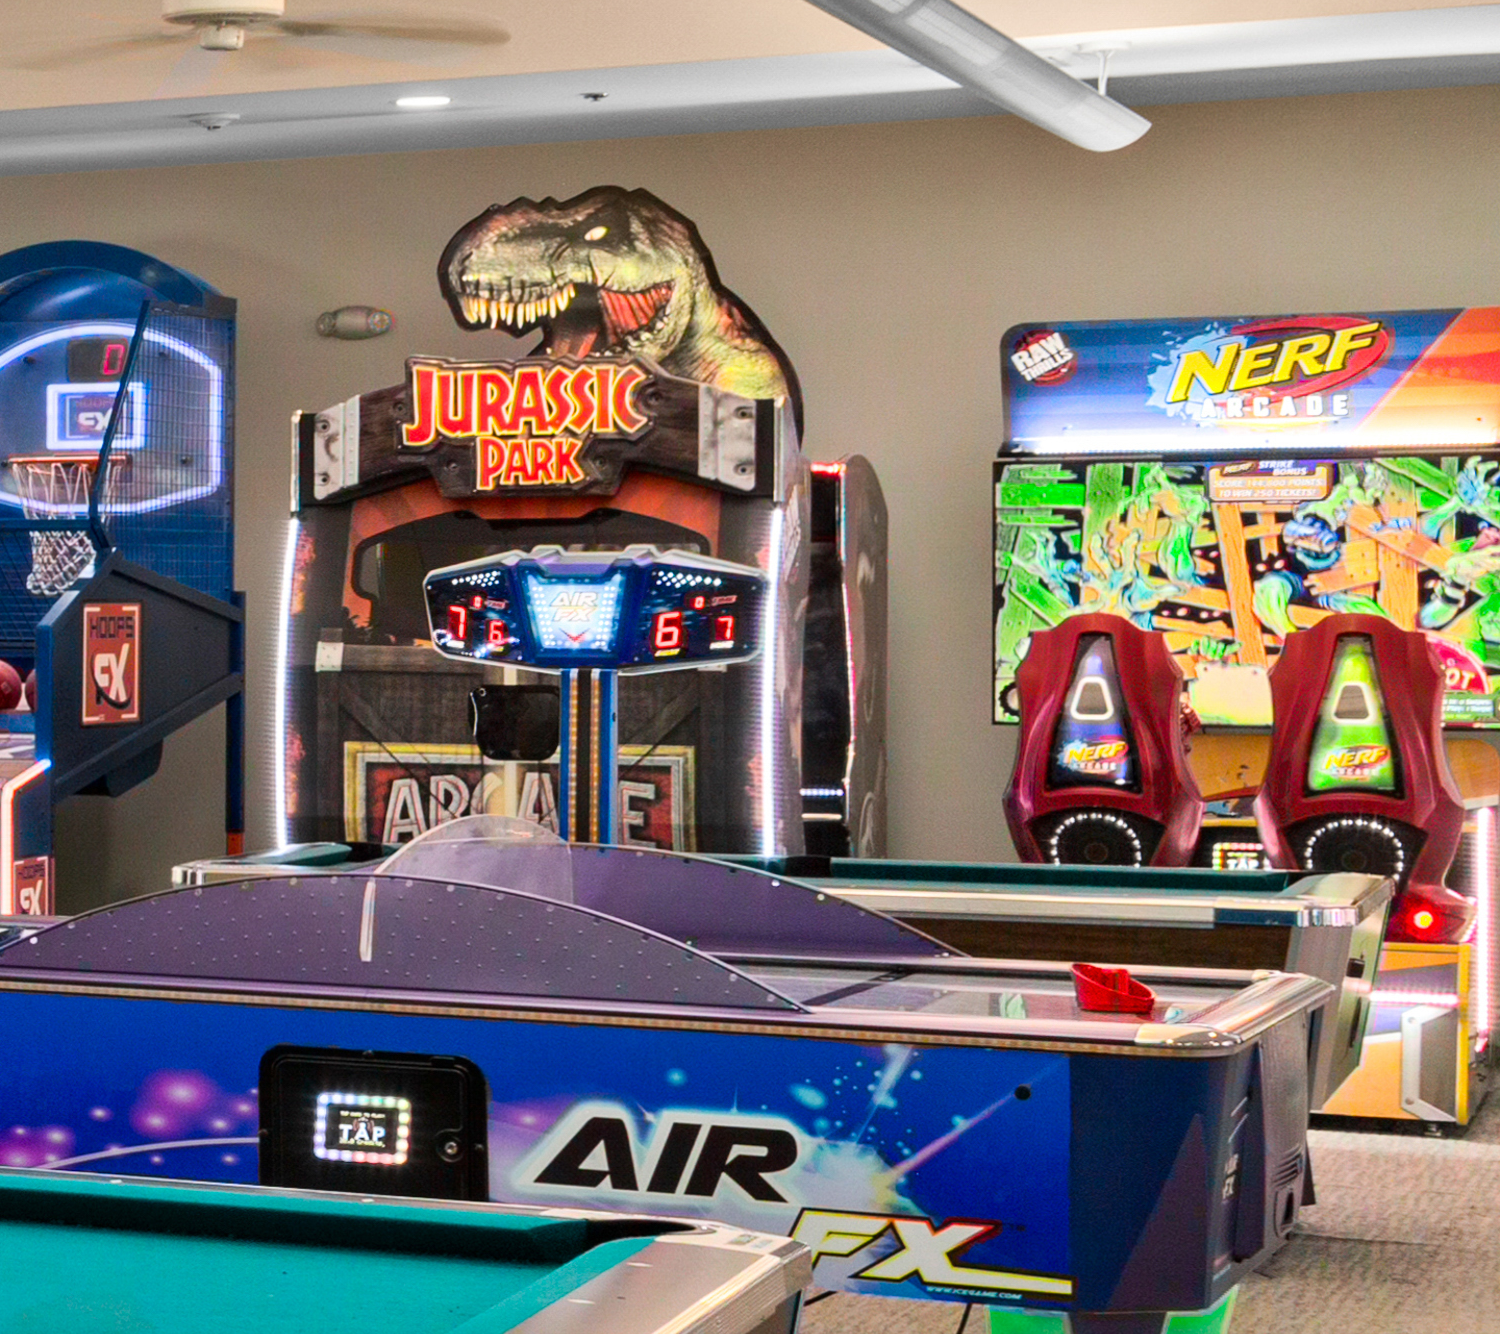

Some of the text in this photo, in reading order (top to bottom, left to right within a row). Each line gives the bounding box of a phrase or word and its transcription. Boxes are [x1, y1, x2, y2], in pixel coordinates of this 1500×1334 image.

[1011, 332, 1066, 372] RAW
[1021, 348, 1074, 381] THRILLS
[1166, 321, 1381, 403] NERF
[402, 365, 648, 446] JURASSIC
[1201, 395, 1349, 418] ARCADE
[477, 437, 584, 490] PARK
[551, 592, 598, 606] AIR
[551, 606, 596, 622] FX
[90, 616, 134, 638] HOOPS
[450, 605, 466, 640] 7
[655, 612, 682, 648] 6
[718, 617, 733, 640] 7
[94, 643, 130, 703] FX
[1065, 742, 1126, 763] NERF
[1324, 747, 1388, 769] NERF
[383, 772, 656, 852] ARCAE
[1227, 858, 1258, 870] TAP
[339, 1122, 386, 1142] TAP
[533, 1115, 798, 1204] AIR
[789, 1207, 1077, 1301] FX
